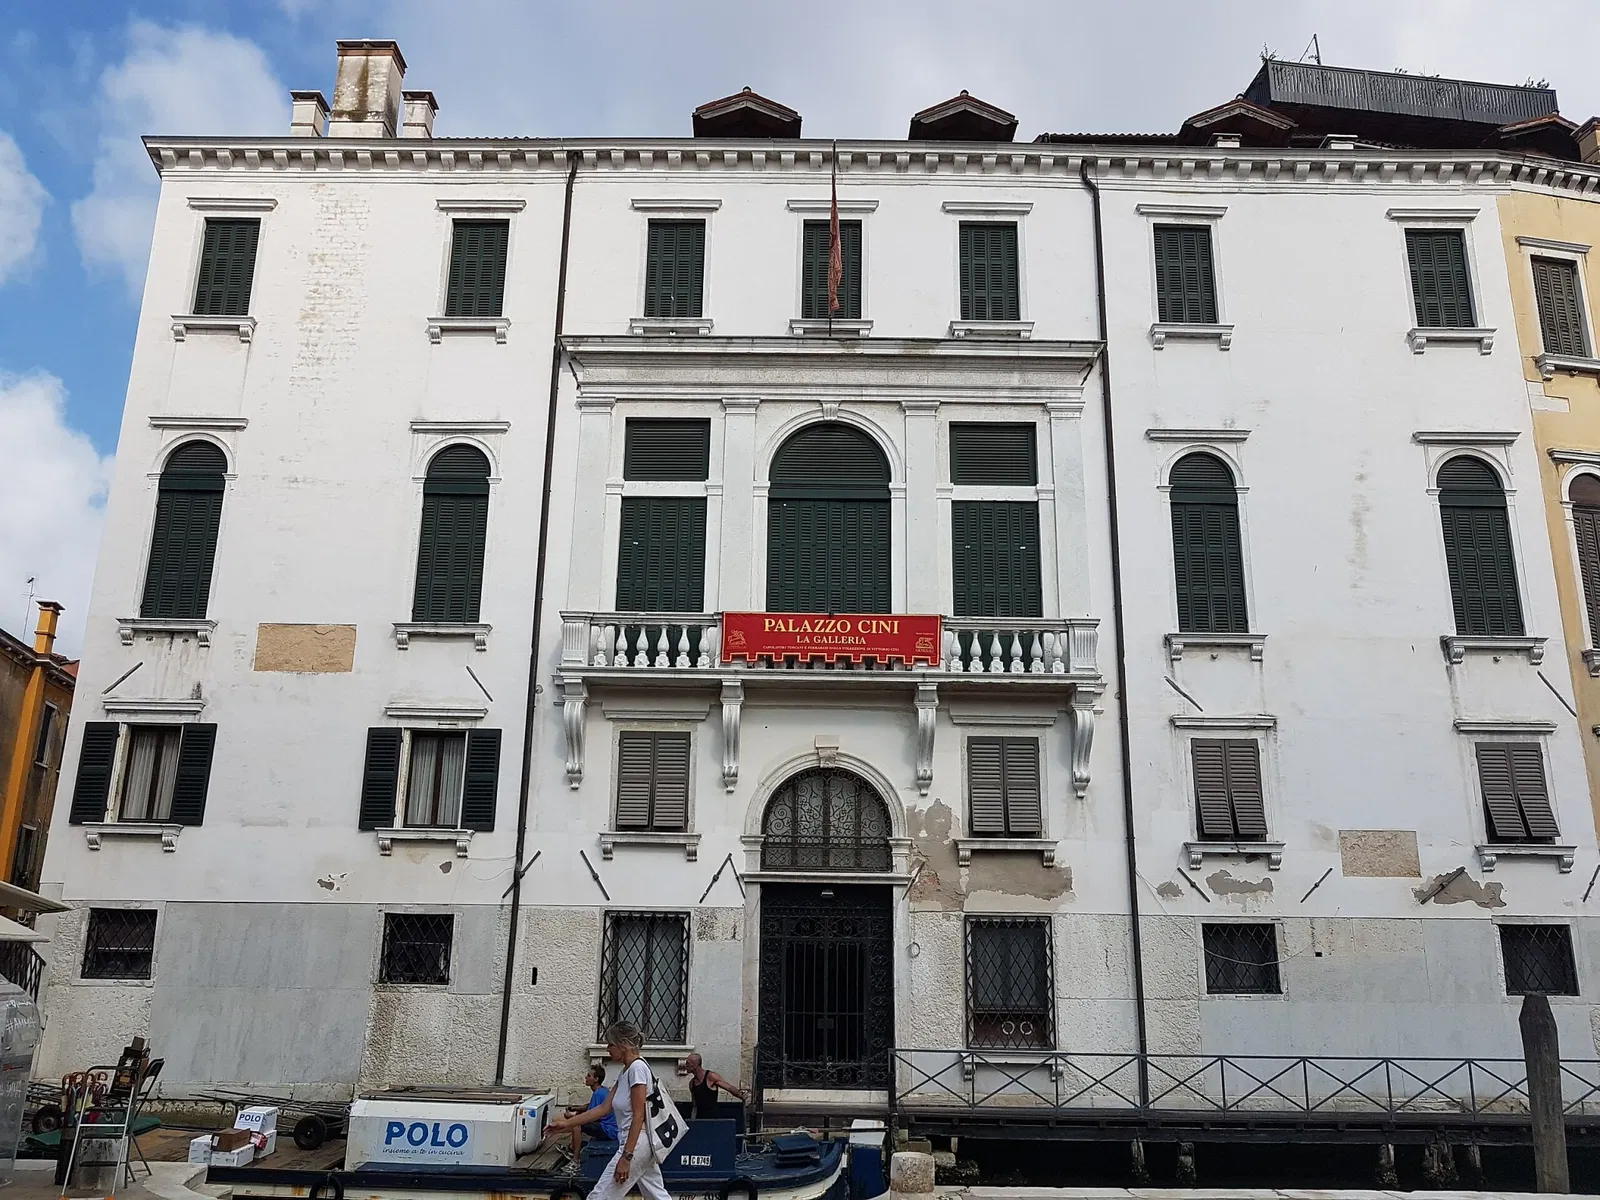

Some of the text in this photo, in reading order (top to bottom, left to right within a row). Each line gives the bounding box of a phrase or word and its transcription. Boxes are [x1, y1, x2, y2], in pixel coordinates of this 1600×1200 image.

[764, 618, 899, 634] PALAZZO CINI
[797, 635, 866, 645] LA GALLERIA
[239, 1113, 261, 1122] POLO
[384, 1121, 469, 1148] POLO
